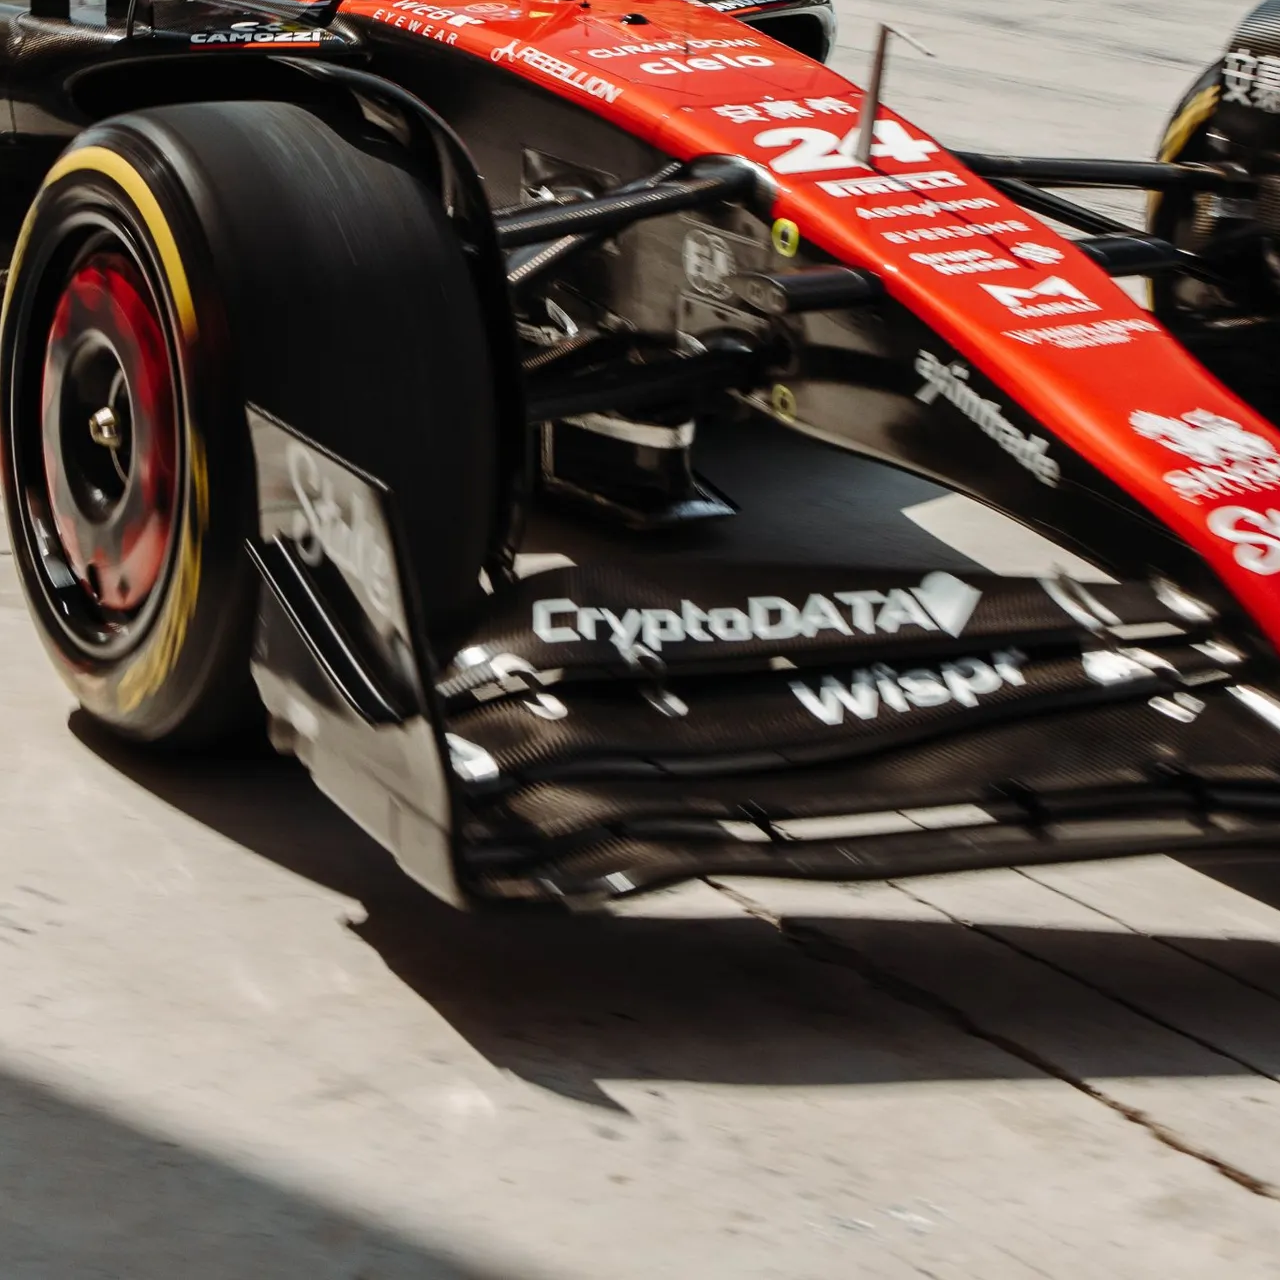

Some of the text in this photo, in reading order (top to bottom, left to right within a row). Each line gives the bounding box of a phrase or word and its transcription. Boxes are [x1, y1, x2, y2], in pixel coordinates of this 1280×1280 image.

[392, 0, 455, 21] WEB
[190, 32, 320, 44] CAMOZZI
[372, 8, 458, 45] EYEWEAR
[587, 42, 687, 59] CURAM
[639, 53, 775, 75] cielo
[517, 45, 624, 103] REBELLION
[753, 119, 940, 175] 24
[814, 170, 968, 198] PIRELLI
[532, 584, 942, 650] CryptoDATA
